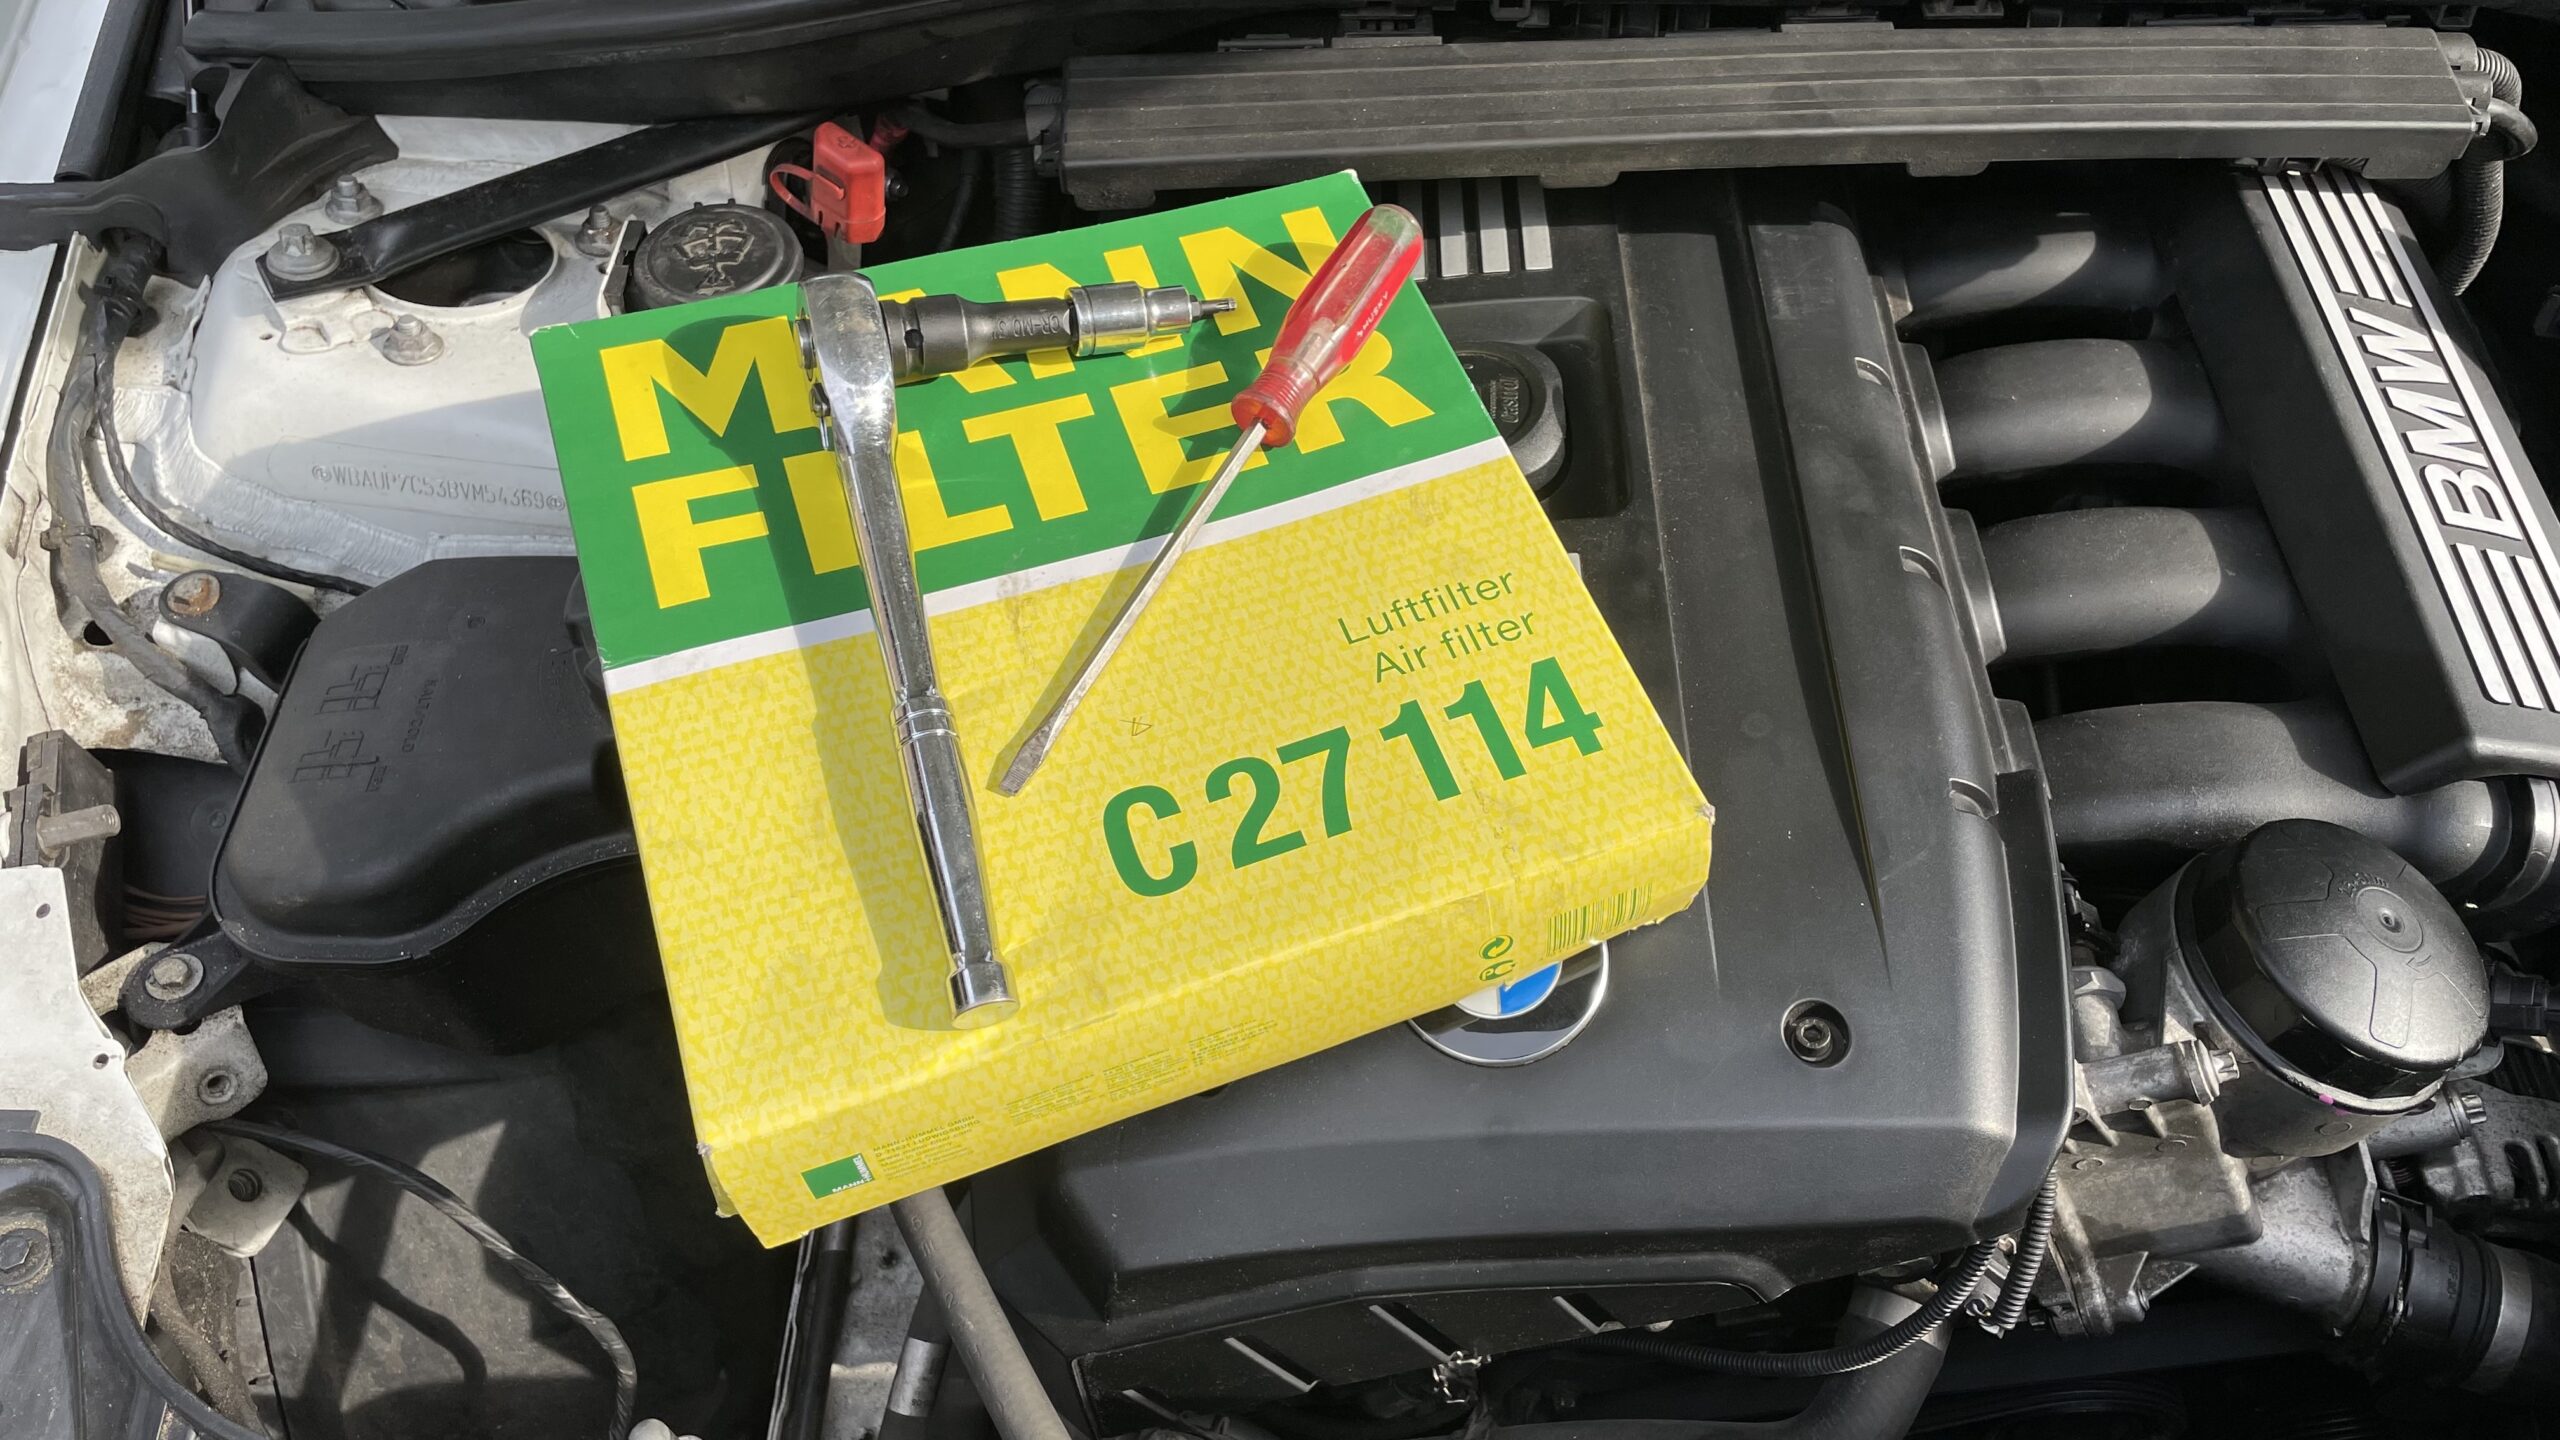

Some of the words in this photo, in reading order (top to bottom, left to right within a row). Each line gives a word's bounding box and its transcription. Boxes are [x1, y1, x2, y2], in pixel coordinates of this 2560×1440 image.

[600, 206, 1340, 462] MNN
[2347, 307, 2524, 541] BMW
[632, 330, 1435, 609] FILTER
[1338, 571, 1514, 645] Luftfilter
[1375, 645, 1427, 683] Air
[1441, 611, 1536, 659] filter
[1103, 785, 1199, 897] C
[1205, 726, 1353, 870] 27
[1379, 656, 1604, 801] 114
